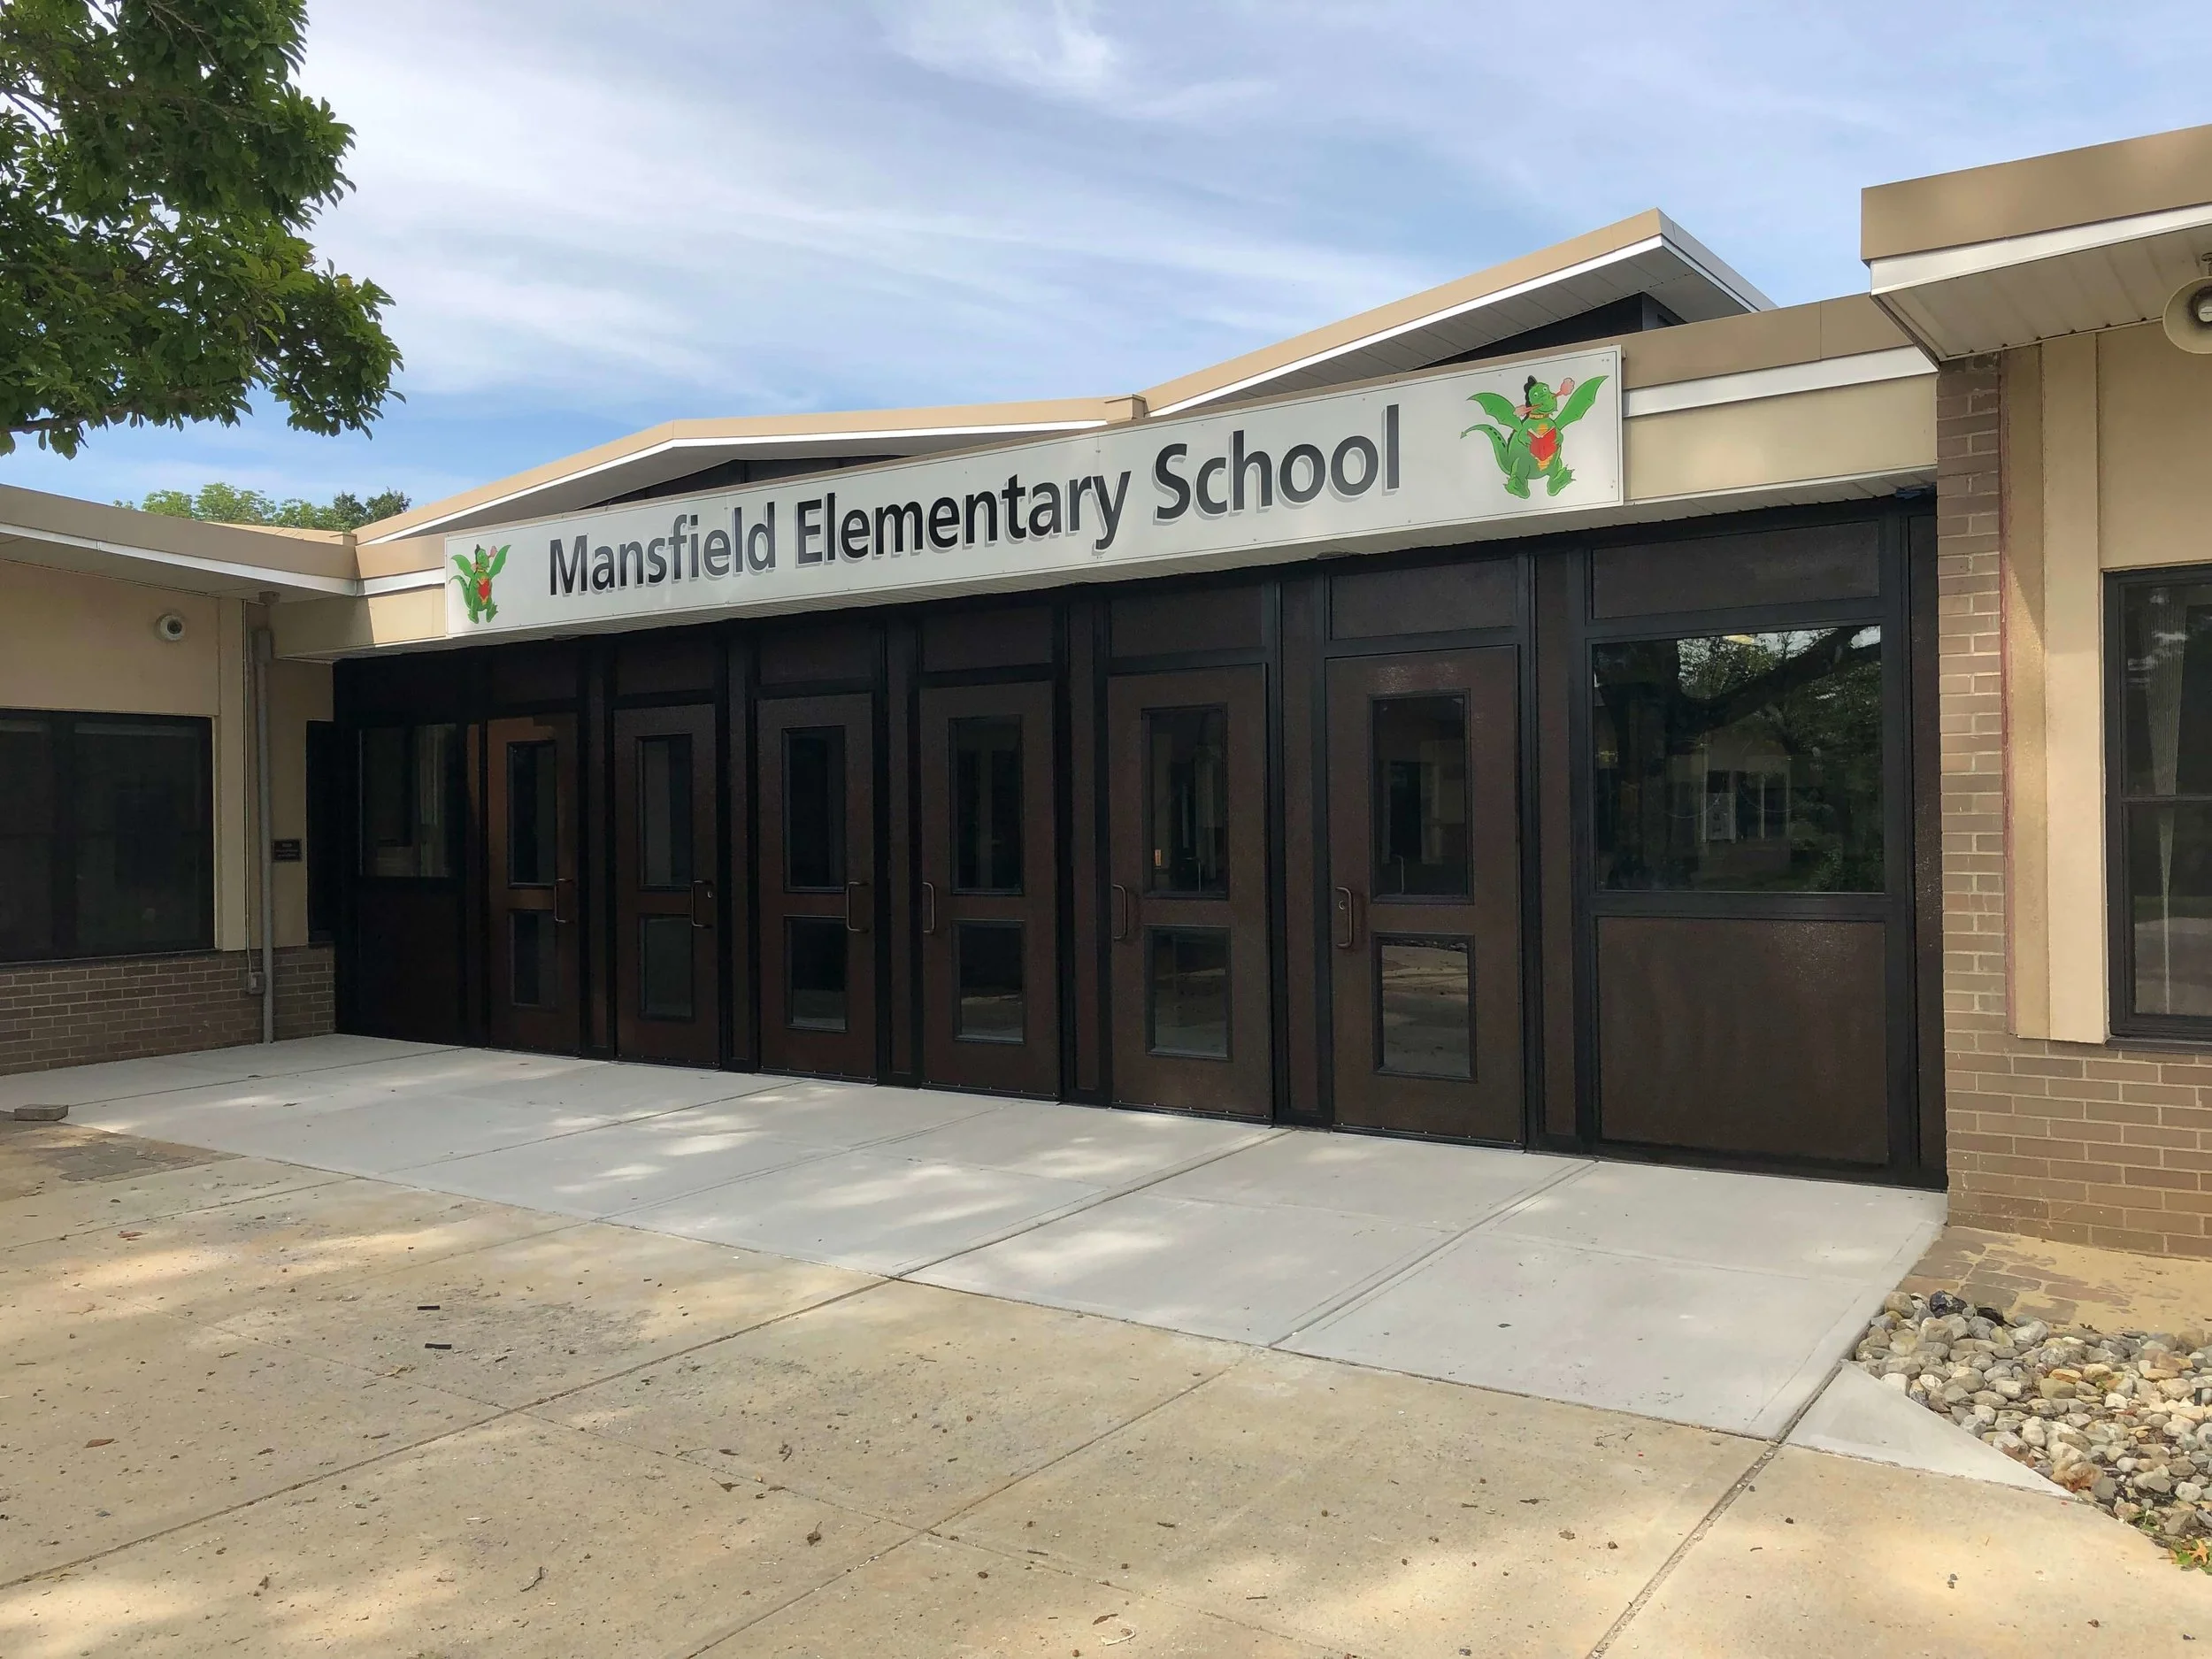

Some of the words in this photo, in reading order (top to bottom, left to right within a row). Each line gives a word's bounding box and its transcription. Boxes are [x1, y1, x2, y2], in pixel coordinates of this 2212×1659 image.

[549, 502, 776, 595] Mansfield
[797, 471, 1132, 564] Elementary
[1156, 404, 1400, 518] School
